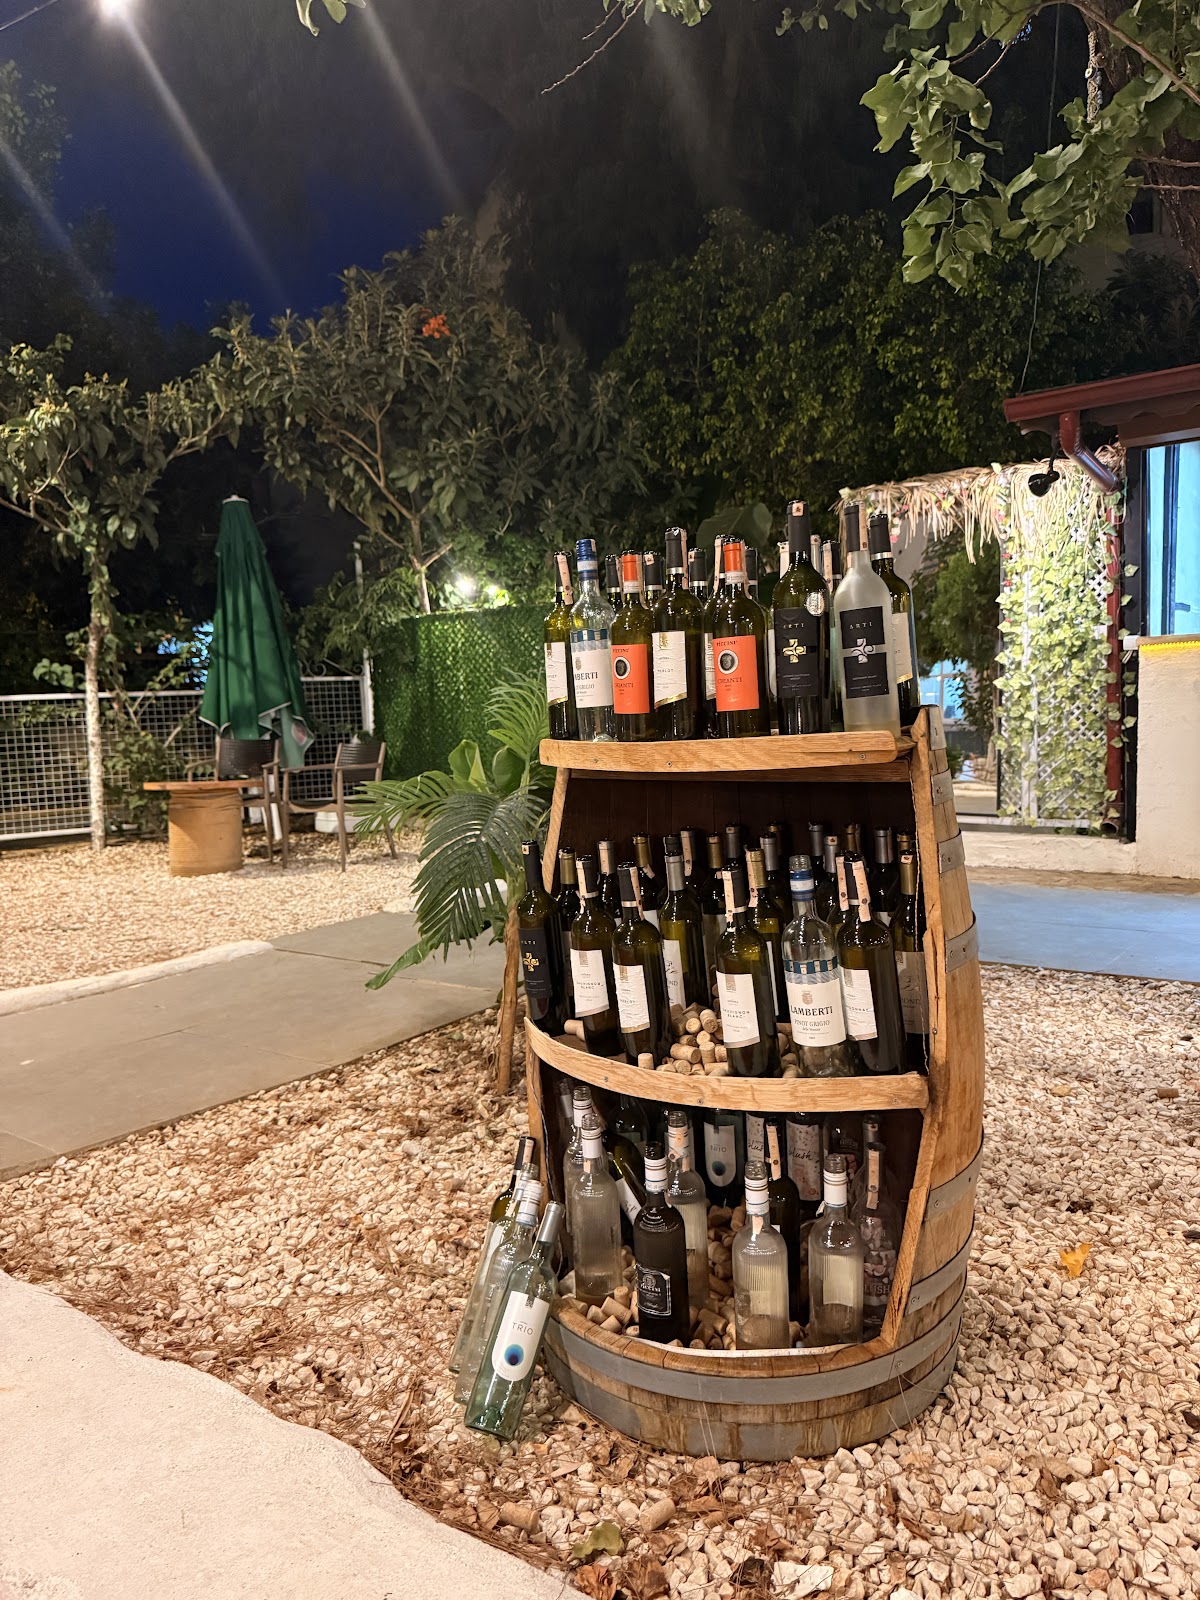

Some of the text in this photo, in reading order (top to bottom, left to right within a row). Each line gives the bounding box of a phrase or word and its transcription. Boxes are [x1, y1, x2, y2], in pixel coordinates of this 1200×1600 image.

[849, 621, 873, 630] ARTI
[790, 1005, 834, 1016] LAMBERTI
[794, 1019, 808, 1027] PINOT
[709, 1144, 727, 1153] TRIO
[511, 1321, 534, 1336] TRIO
